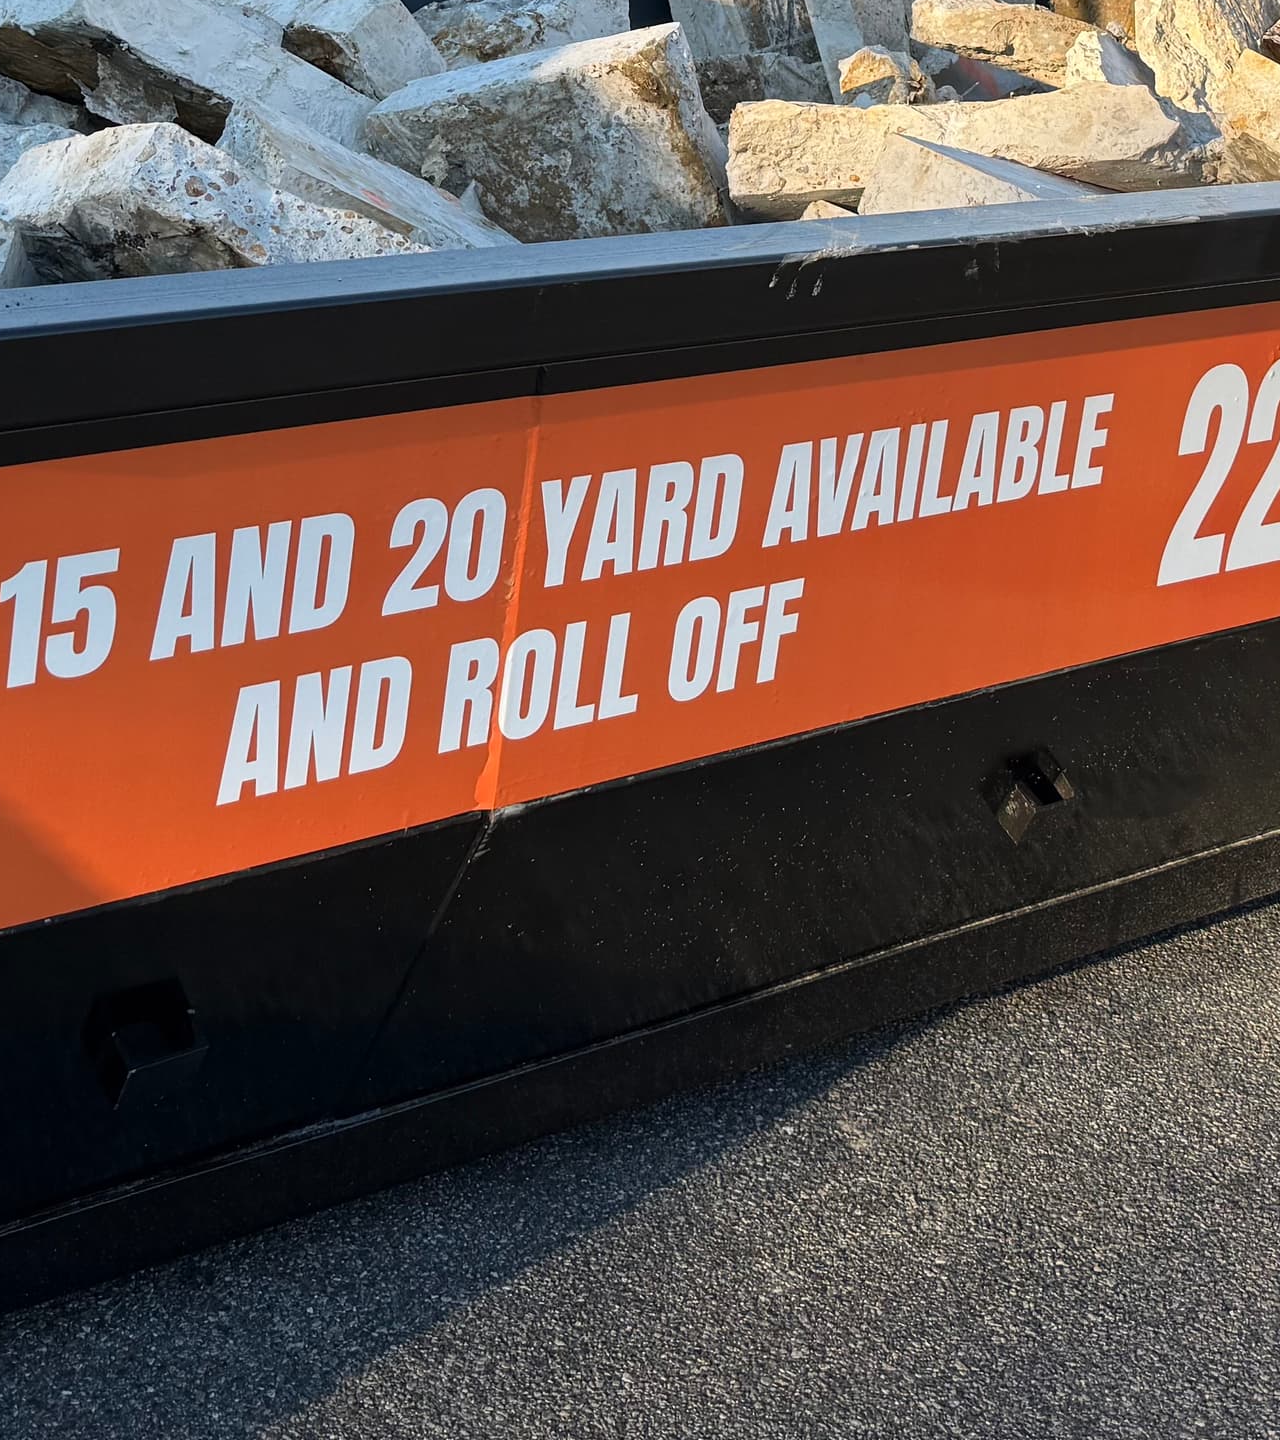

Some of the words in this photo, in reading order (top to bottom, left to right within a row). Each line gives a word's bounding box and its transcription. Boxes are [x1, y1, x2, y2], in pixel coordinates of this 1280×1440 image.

[149, 512, 356, 662] AND
[381, 487, 507, 617] 20
[541, 440, 745, 588] YARD
[761, 393, 1115, 549] AVAILABLE
[215, 655, 413, 807] AND
[437, 613, 639, 755] ROLL
[667, 577, 805, 702] OFF
